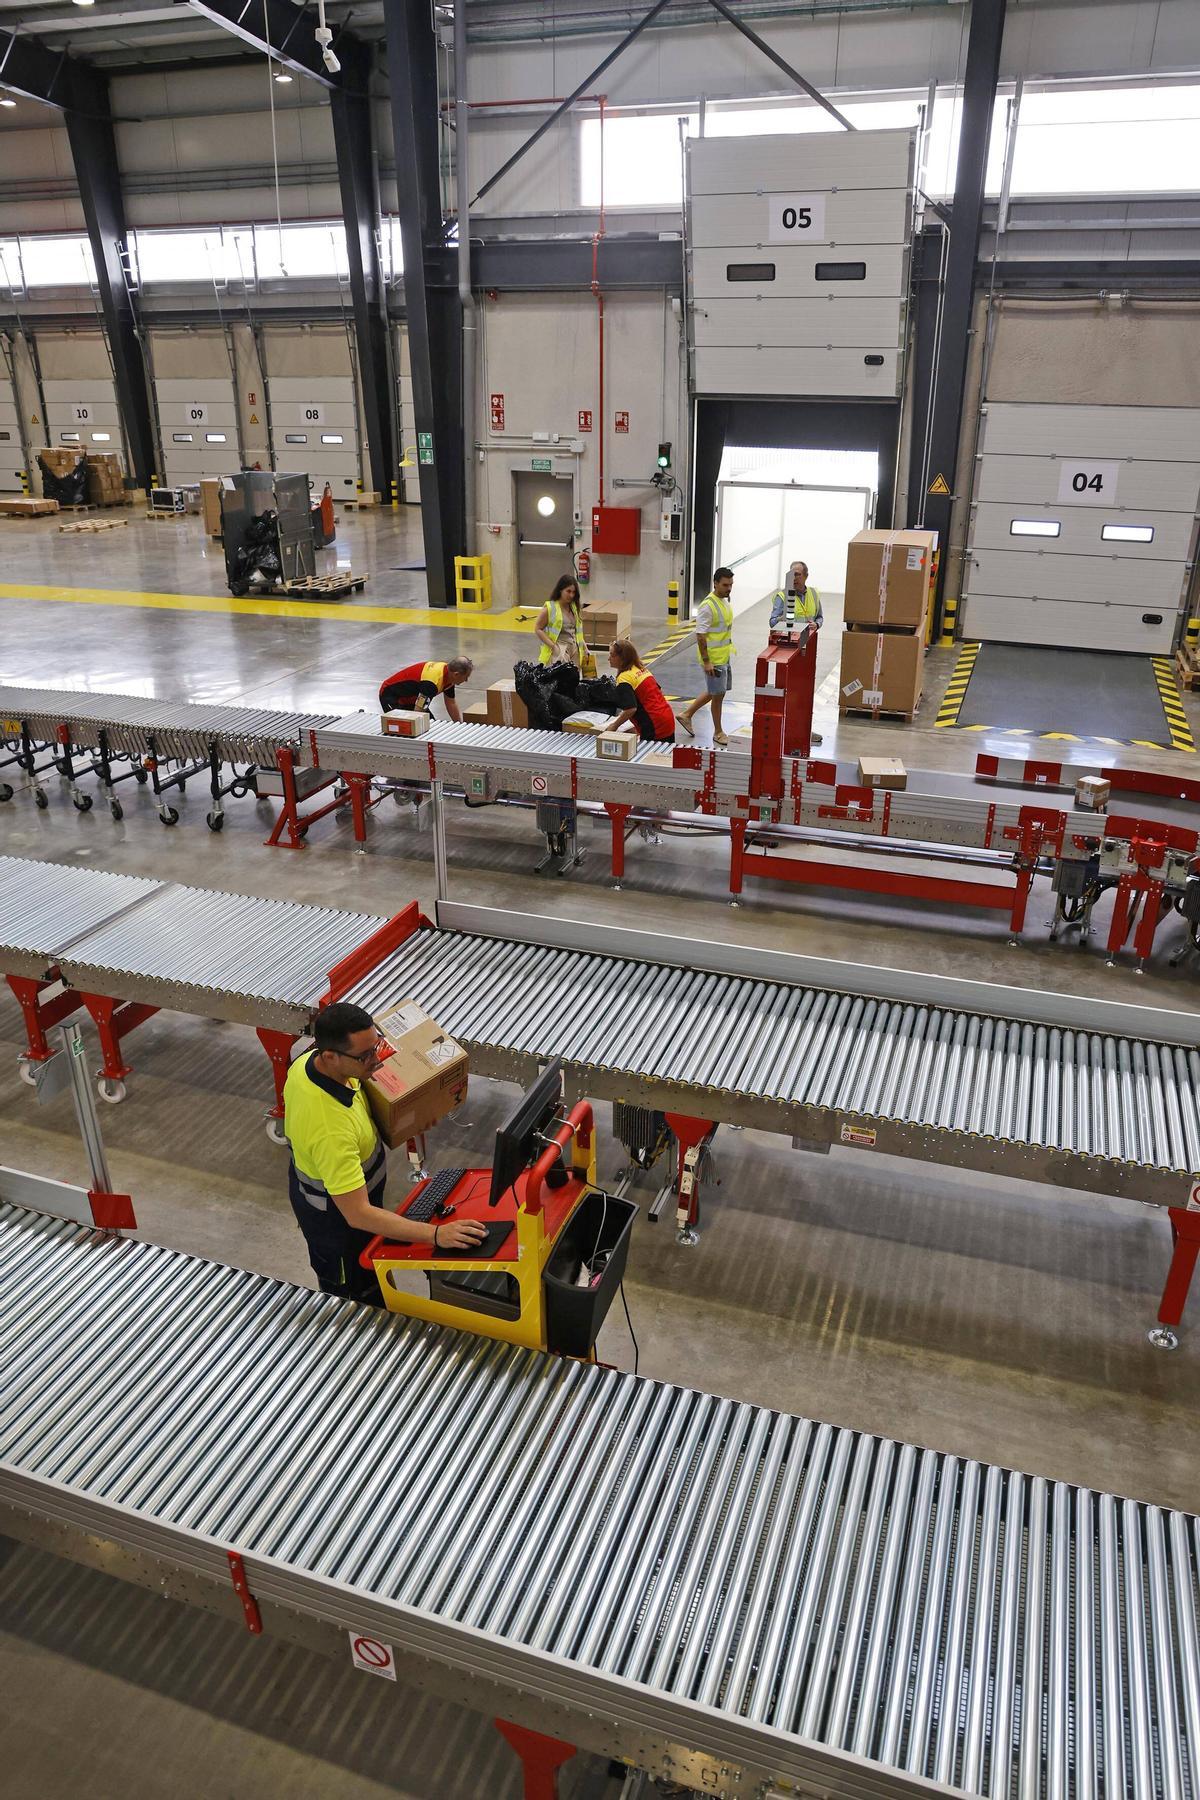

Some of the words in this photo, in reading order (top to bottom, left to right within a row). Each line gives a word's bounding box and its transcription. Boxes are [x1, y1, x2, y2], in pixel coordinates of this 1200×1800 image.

[782, 208, 812, 229] 05
[76, 409, 88, 419] 10
[191, 410, 203, 420] 09
[305, 410, 319, 420] 08
[1072, 472, 1104, 493] 04
